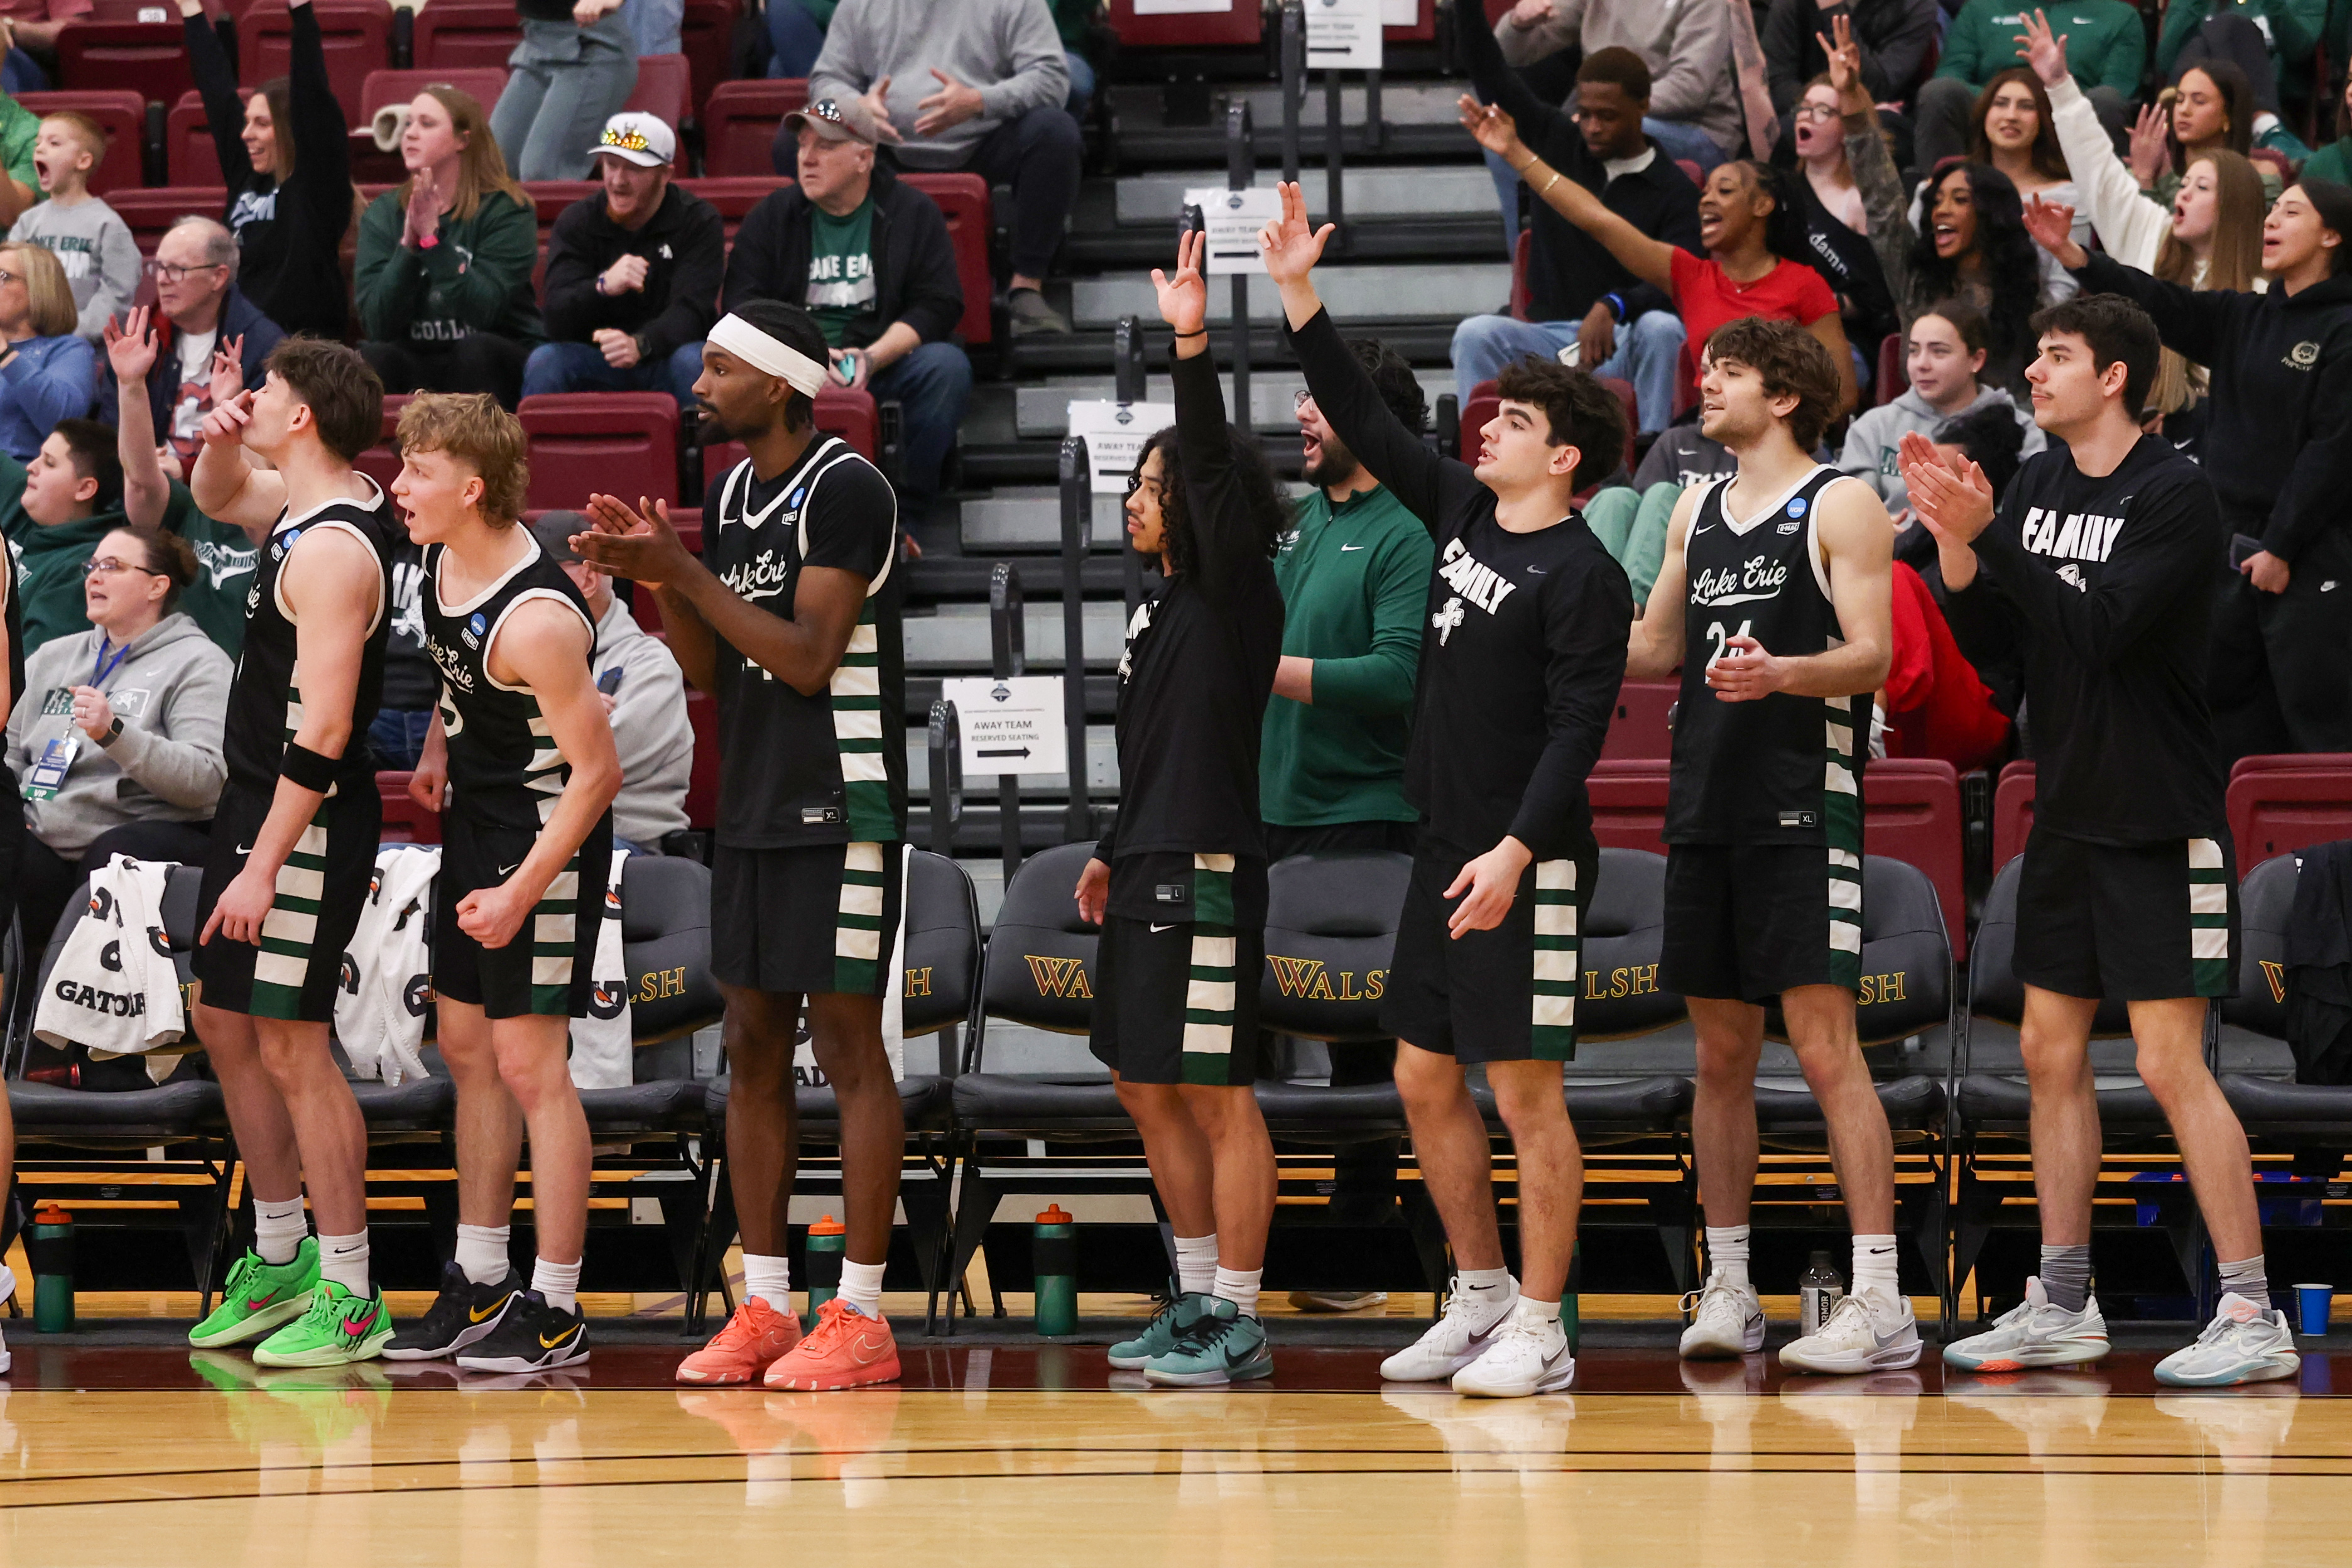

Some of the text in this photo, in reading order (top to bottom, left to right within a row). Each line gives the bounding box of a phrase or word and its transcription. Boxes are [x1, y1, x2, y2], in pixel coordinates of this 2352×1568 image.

[2022, 506, 2125, 563] FAMILY
[1438, 536, 1517, 616] FAMILY
[1690, 555, 1787, 605] Lake Erie
[446, 645, 474, 689] Erie
[974, 720, 1032, 730] AWAY TEAM
[33, 788, 47, 798] VIP
[1802, 815, 1813, 823] XL
[1266, 954, 1390, 1000] WALS
[1821, 1295, 1829, 1325] RMOR
